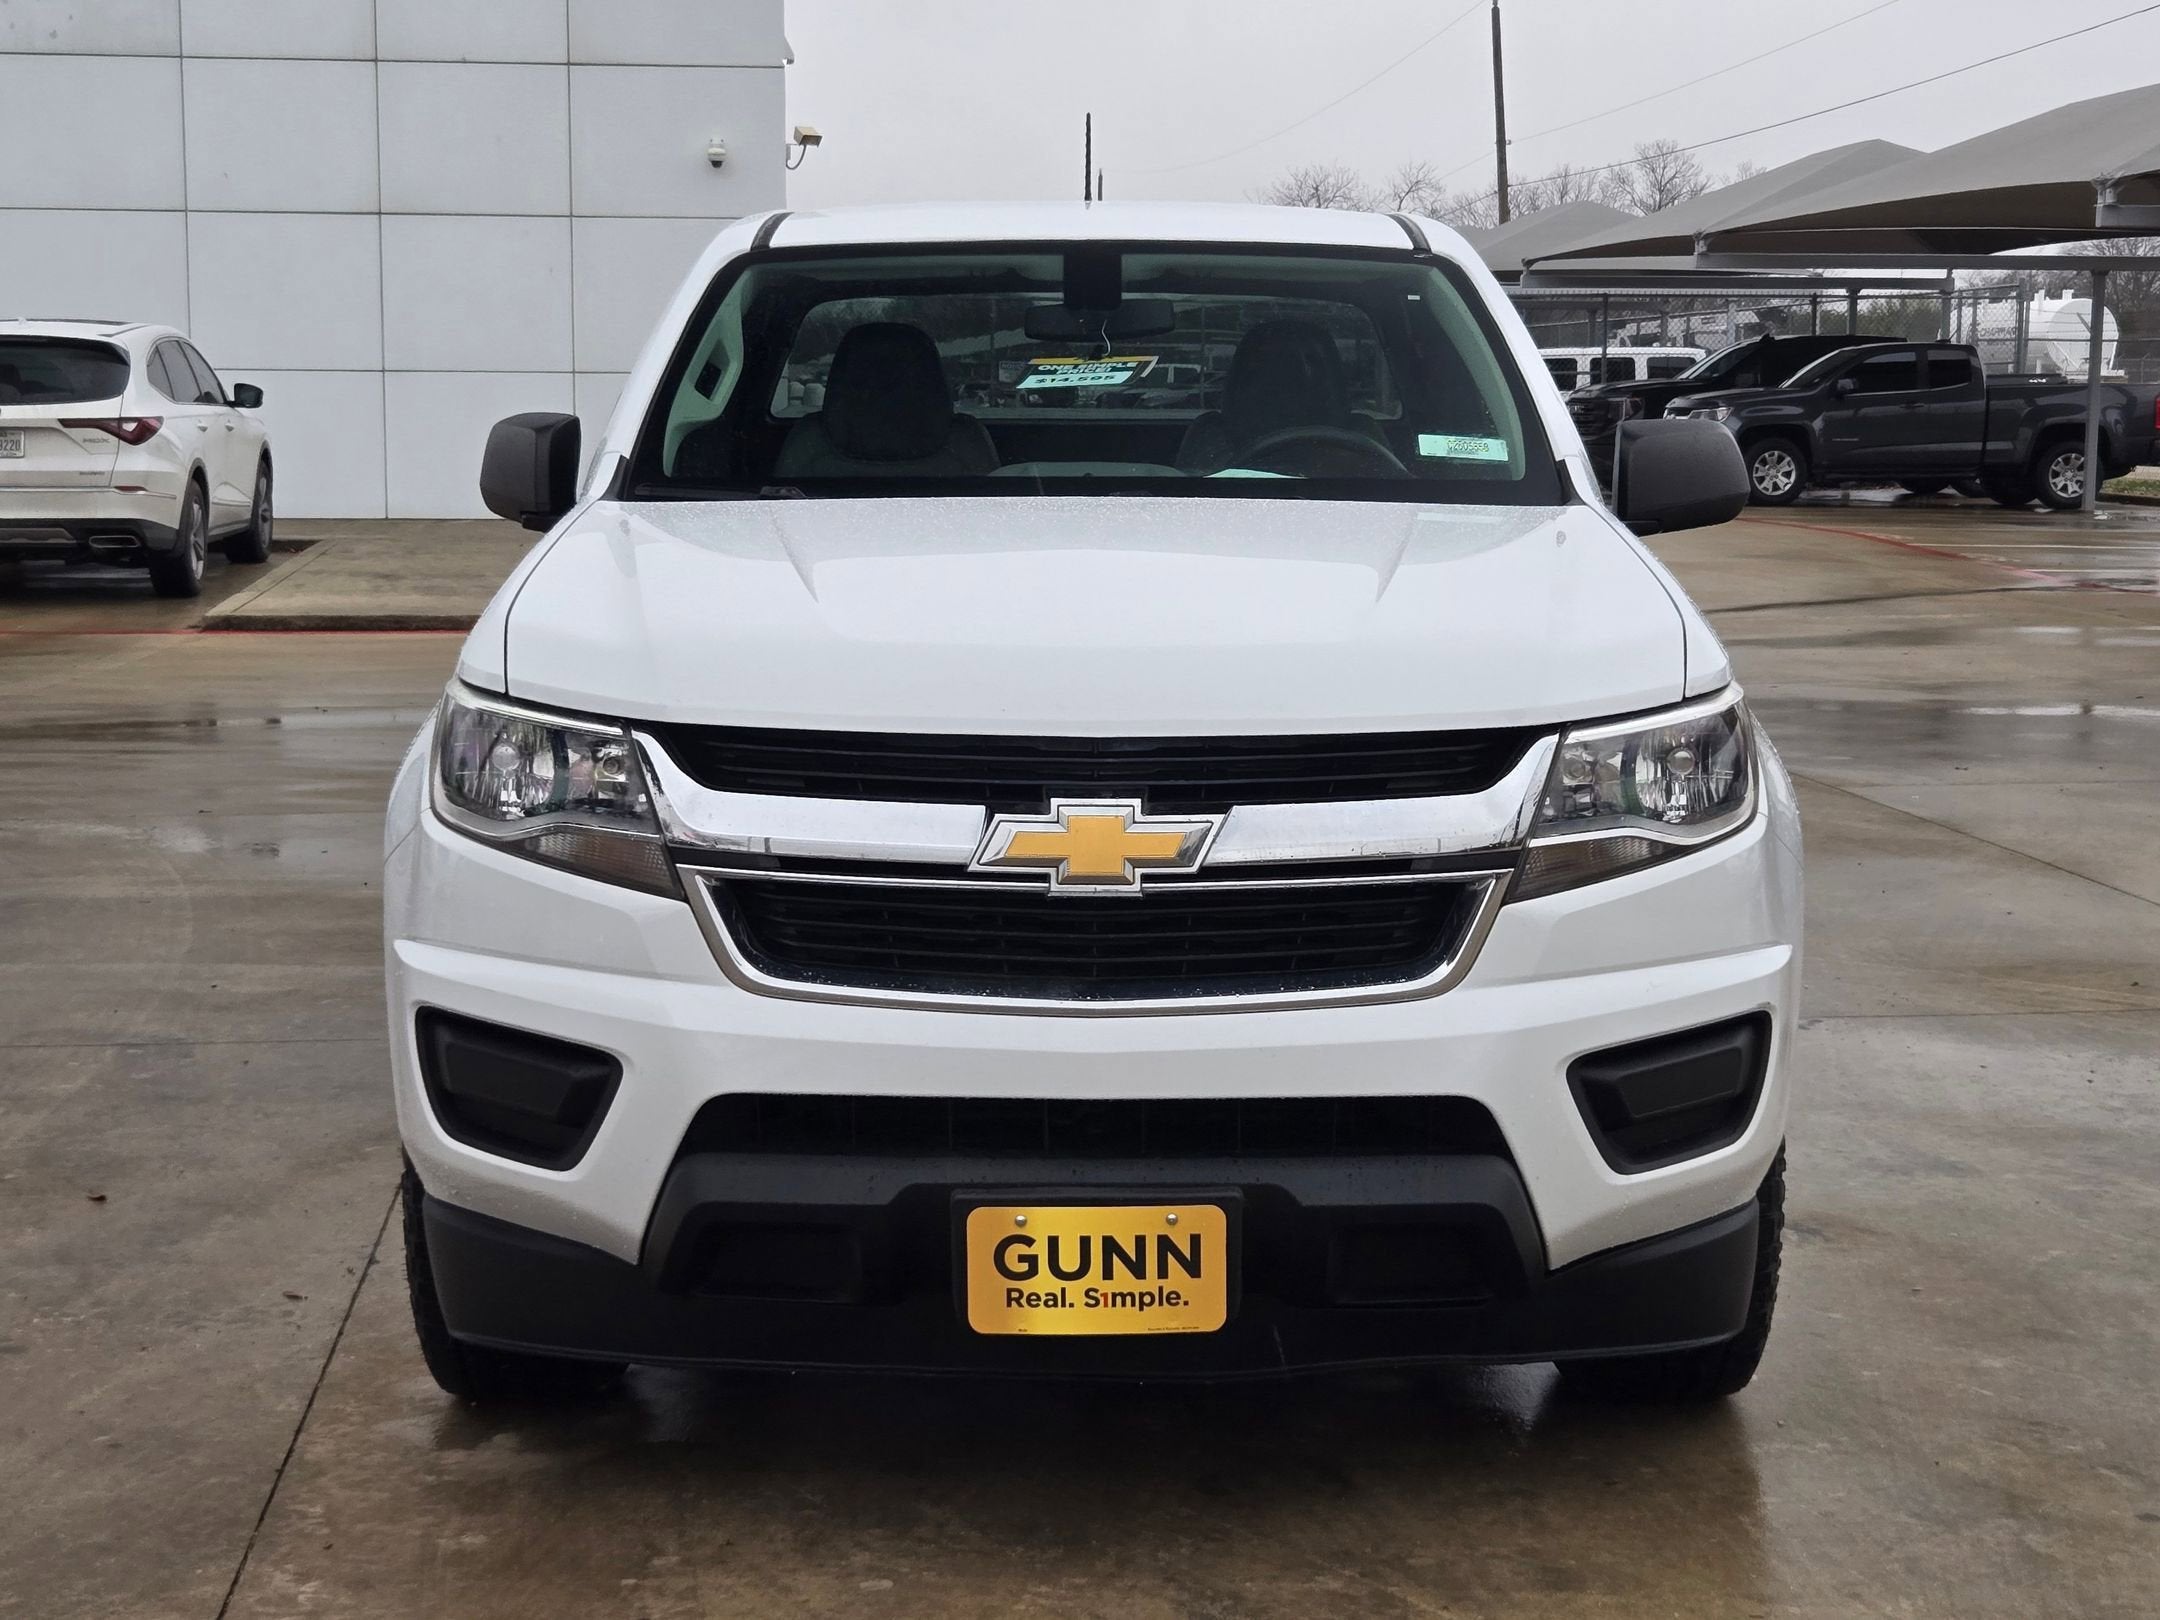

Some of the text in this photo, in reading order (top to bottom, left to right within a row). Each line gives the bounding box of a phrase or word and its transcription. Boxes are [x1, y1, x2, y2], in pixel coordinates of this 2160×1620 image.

[1038, 362, 1139, 372] ONE SIMPLE
[993, 1233, 1202, 1282] GUNN
[1006, 1287, 1075, 1308] Real.
